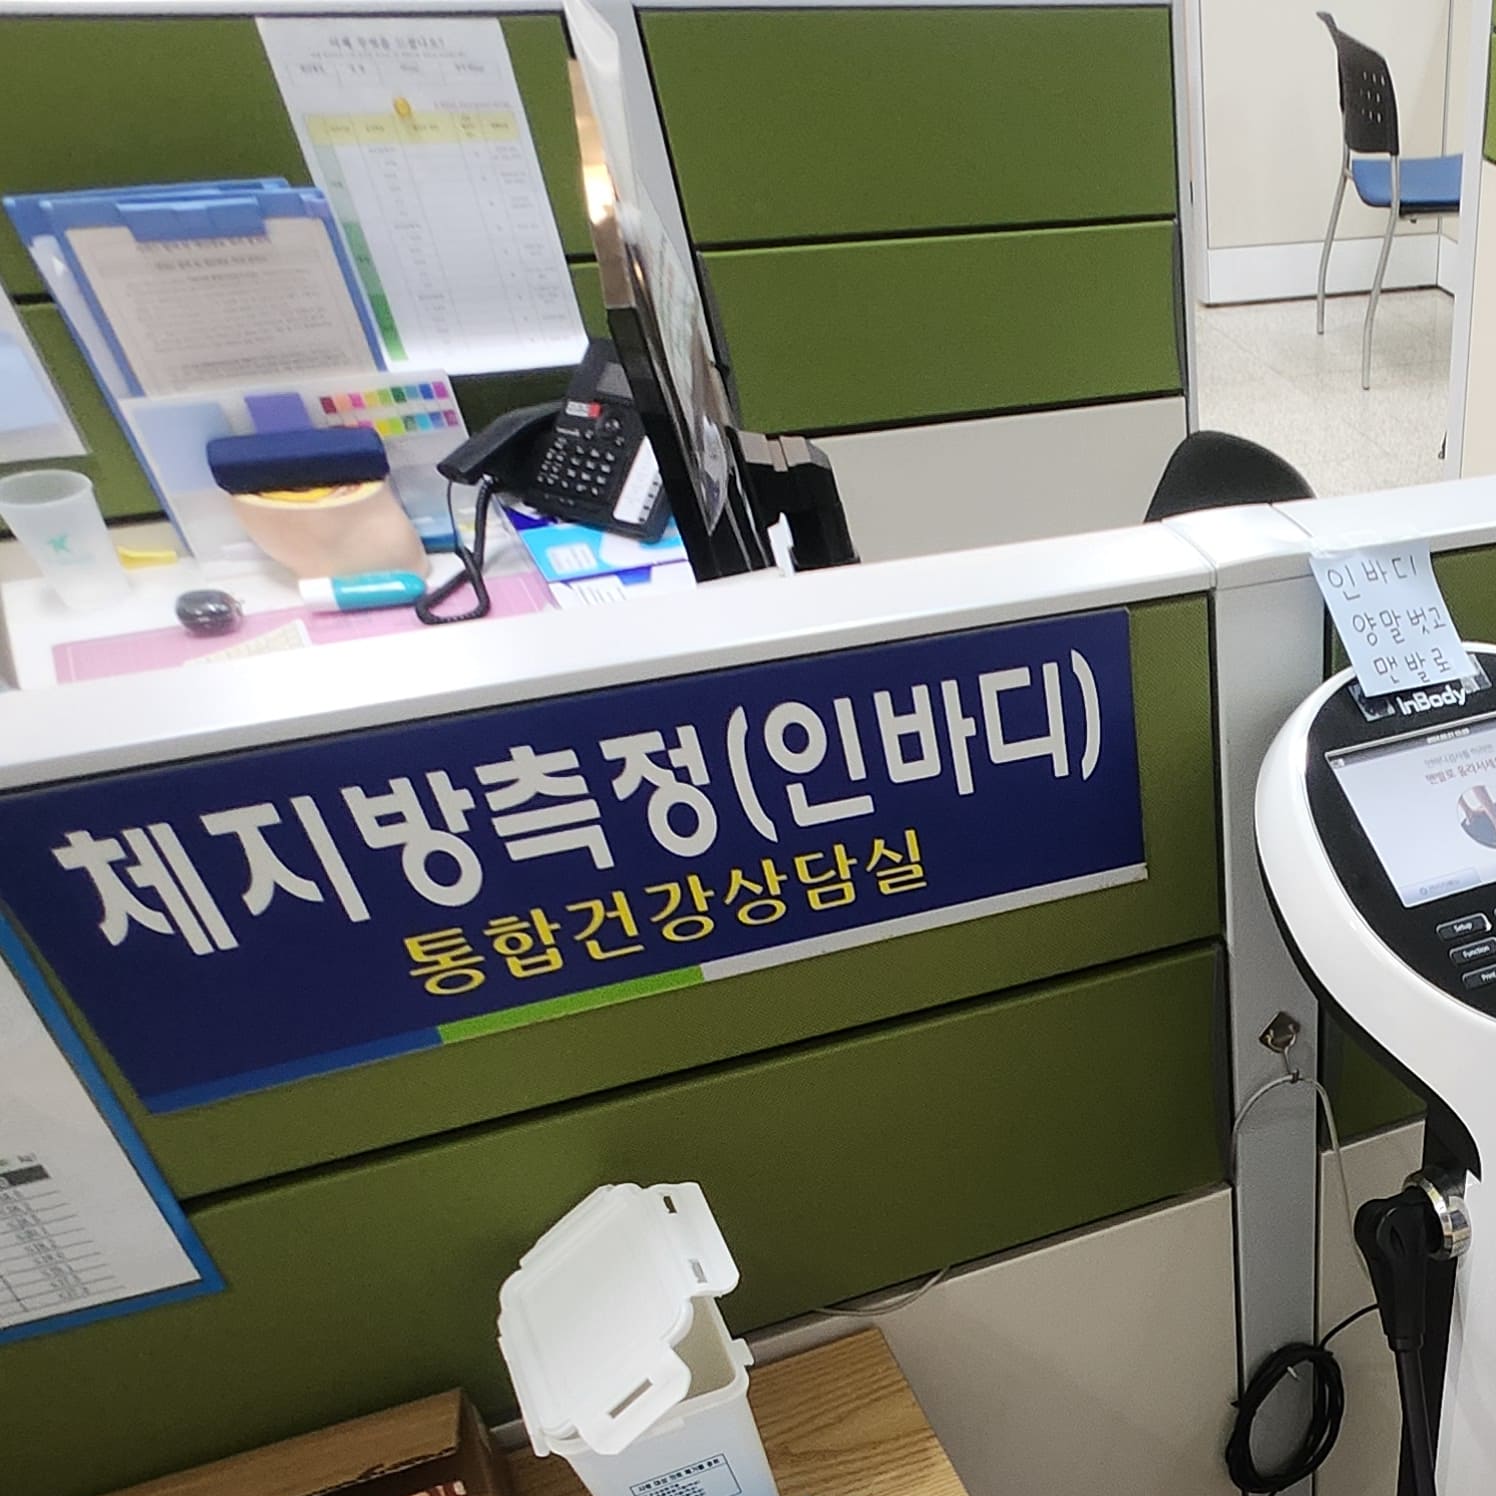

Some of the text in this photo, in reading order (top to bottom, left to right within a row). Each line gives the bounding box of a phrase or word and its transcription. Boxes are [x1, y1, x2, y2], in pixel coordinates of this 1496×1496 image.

[1328, 555, 1417, 601] 인바디
[1373, 648, 1450, 684] 맨발로
[1396, 684, 1467, 716] InBody
[51, 648, 1103, 957] 체지방측정(인바디)
[403, 828, 930, 997] 통합건강상담실
[1453, 921, 1474, 933] Setup
[1462, 944, 1491, 959] Function
